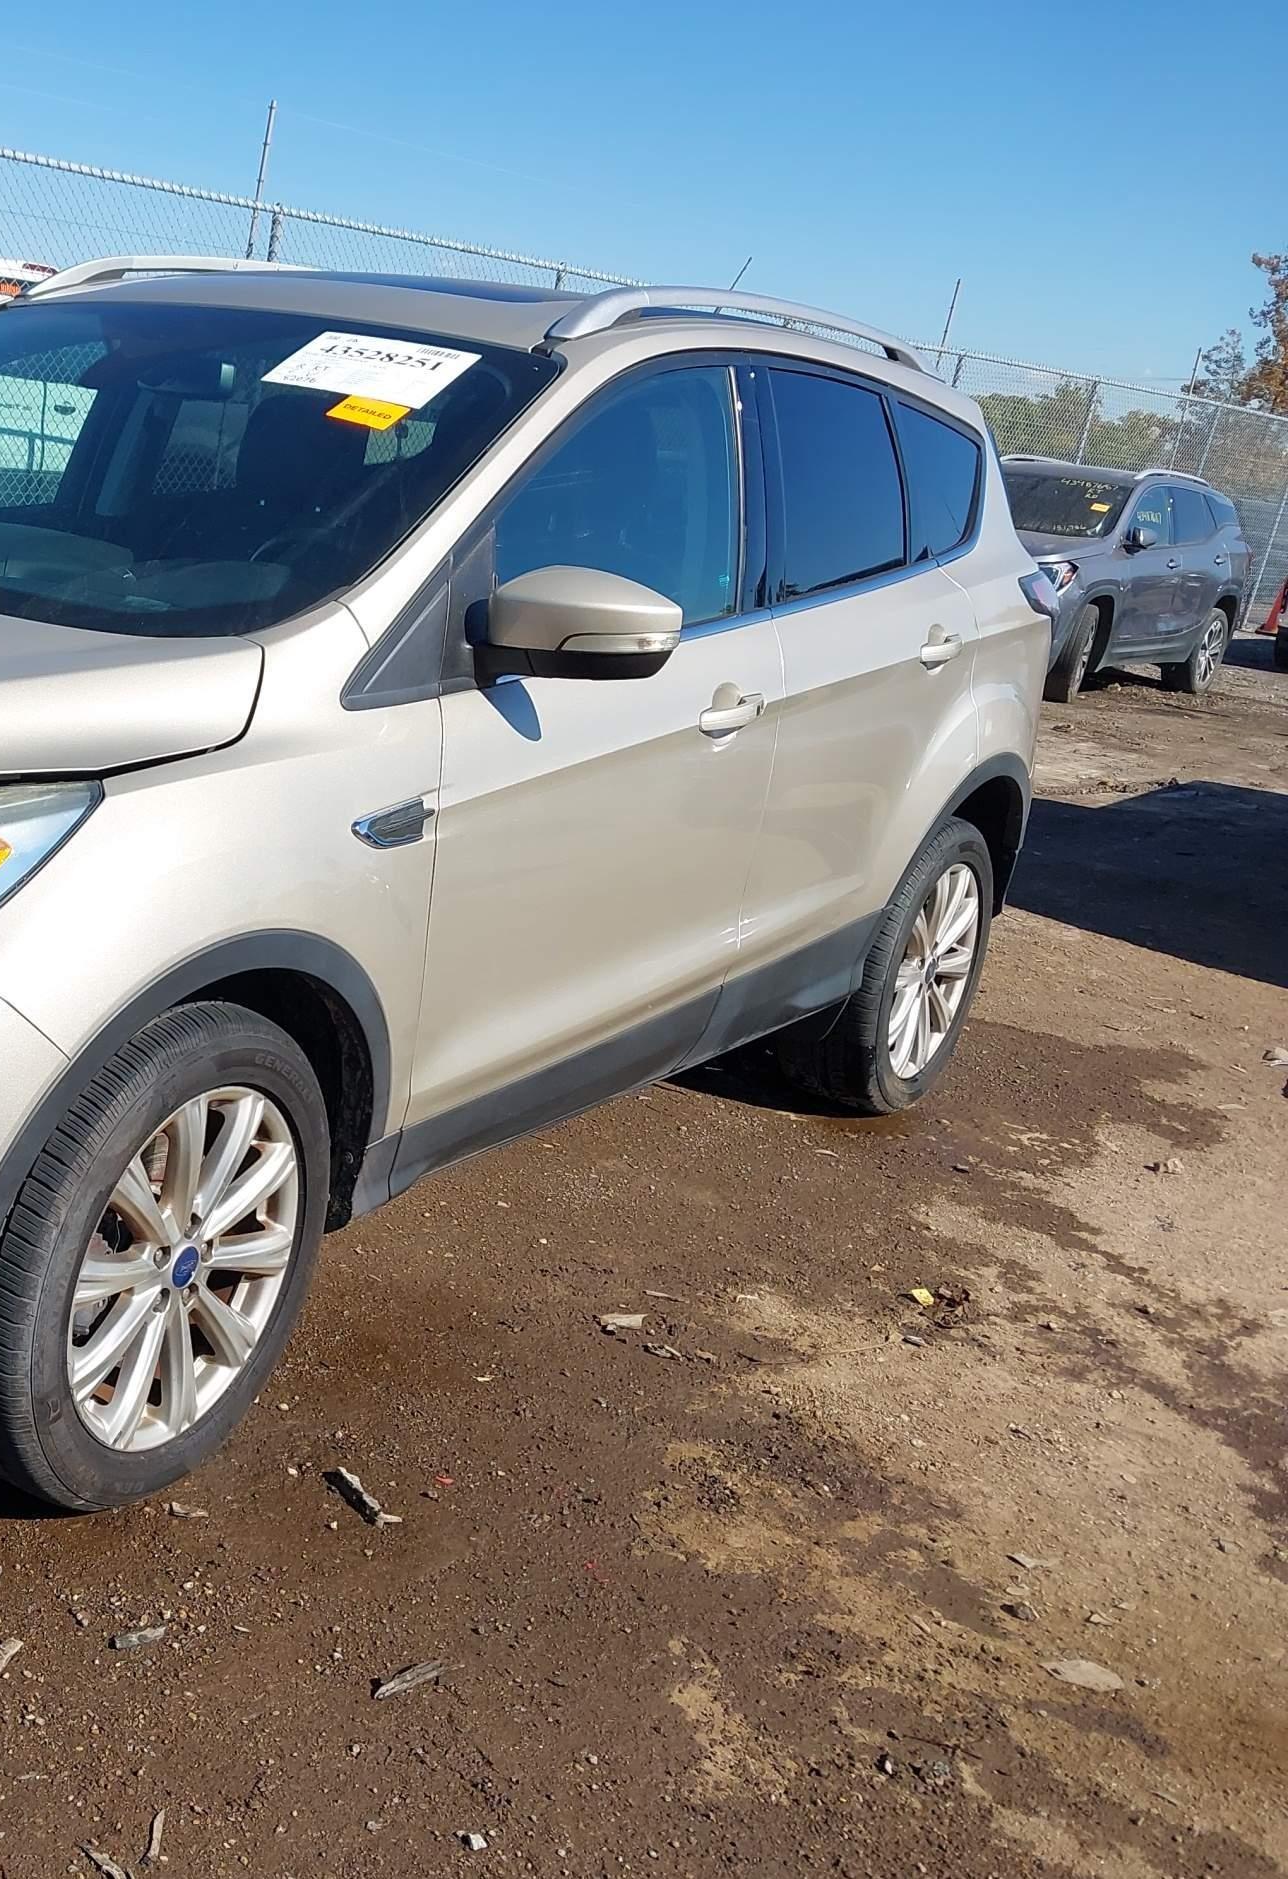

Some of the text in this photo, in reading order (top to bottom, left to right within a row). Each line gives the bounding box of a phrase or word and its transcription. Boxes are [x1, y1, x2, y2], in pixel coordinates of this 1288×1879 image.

[319, 344, 444, 372] 43528251
[342, 403, 392, 421] DETAILED
[255, 1053, 313, 1104] GENERAL
